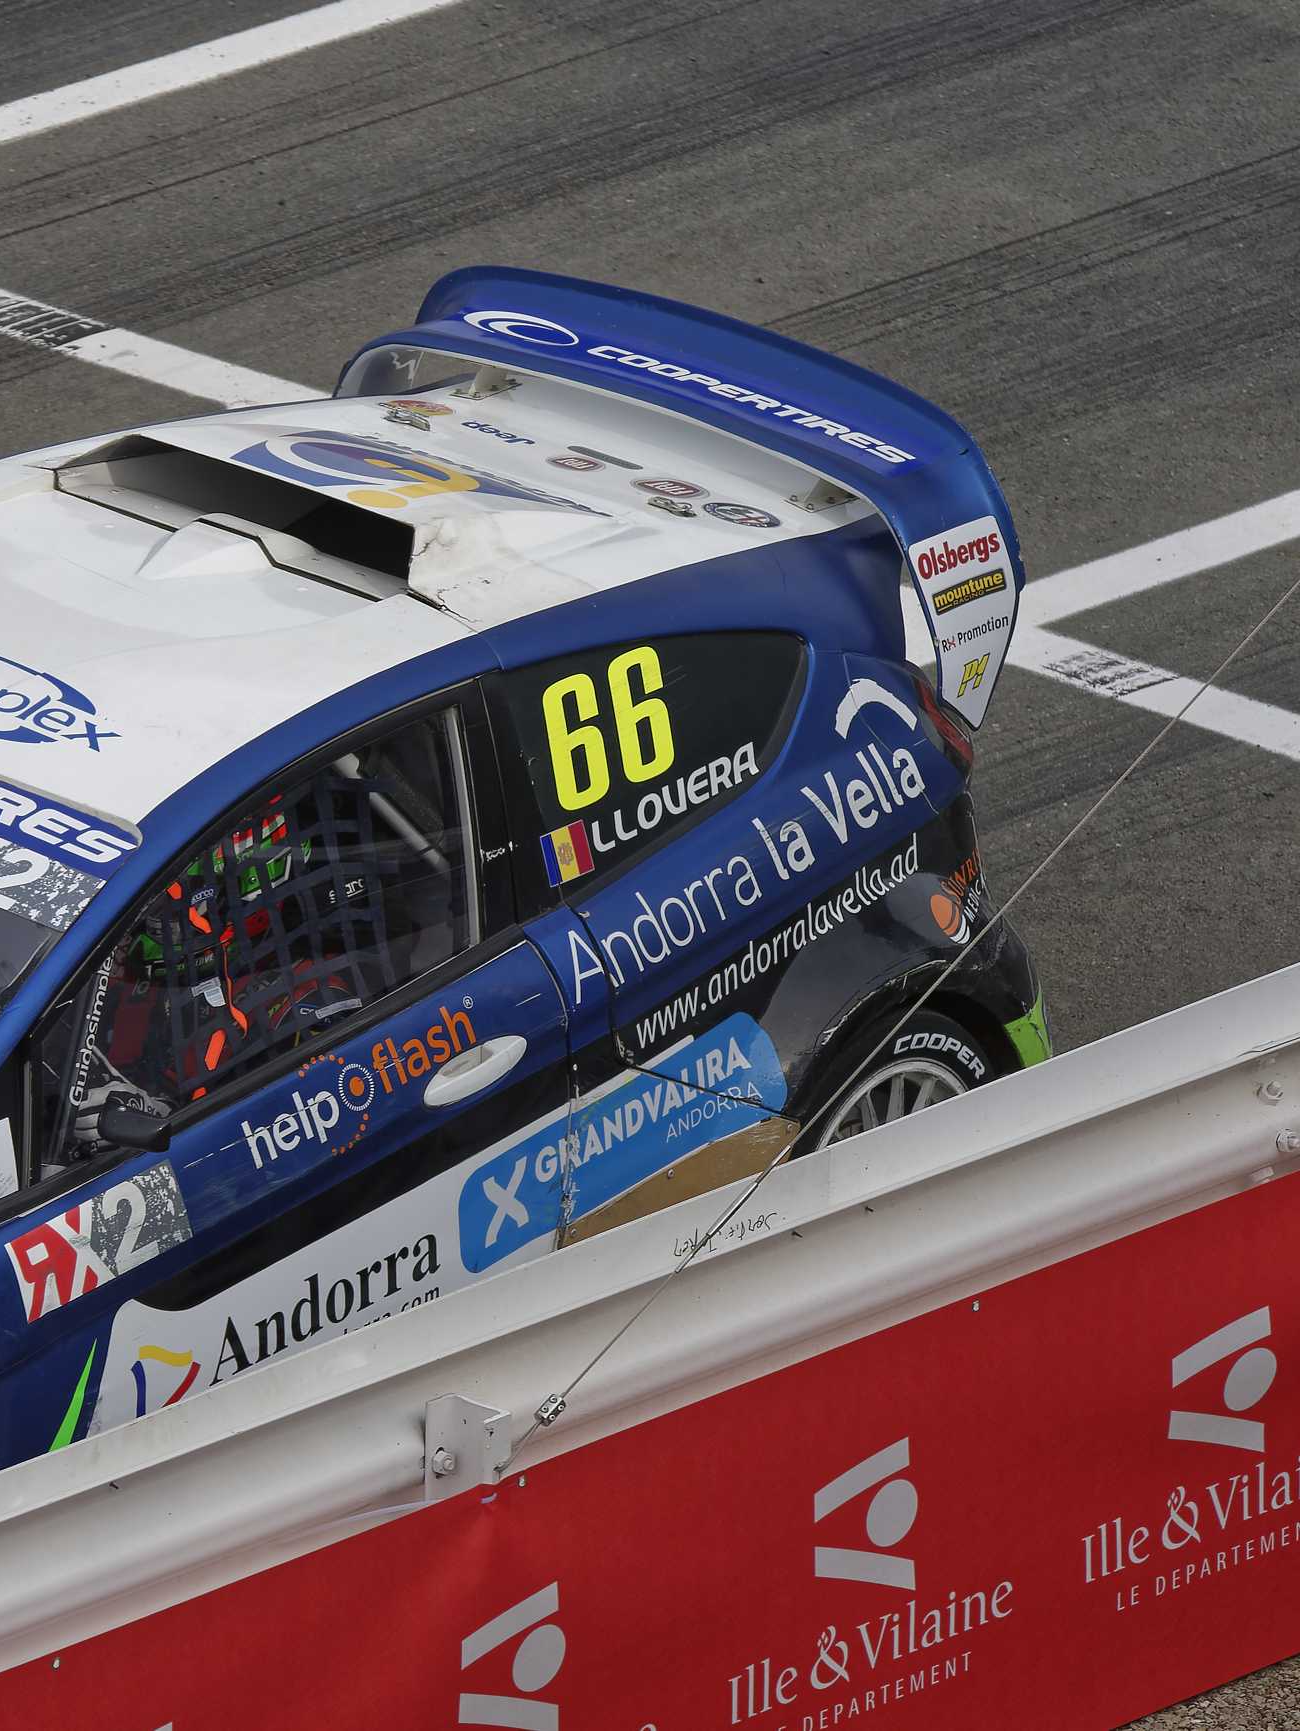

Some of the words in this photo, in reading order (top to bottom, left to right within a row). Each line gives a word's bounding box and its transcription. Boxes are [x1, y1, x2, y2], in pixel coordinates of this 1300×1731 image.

[460, 418, 537, 447] Jeep
[587, 343, 917, 466] COOPERTIRES
[917, 531, 1001, 580] Olsbergs
[933, 571, 1005, 609] mountune
[952, 588, 986, 608] RACING
[957, 614, 1010, 646] Promotion
[542, 646, 676, 812] 66
[568, 855, 763, 1005] Andorra
[751, 817, 817, 881] la
[800, 743, 927, 845] Vella
[635, 832, 920, 1050] www.andorralavella.ad
[893, 1032, 985, 1080] COOPER
[241, 1090, 341, 1169] help
[534, 1036, 753, 1184] GRANDVALIRA
[665, 1081, 764, 1143] ANDORRA
[209, 1233, 441, 1387] Andorra
[1082, 1516, 1150, 1584] Ille
[1162, 1485, 1202, 1550] &
[1116, 1584, 1140, 1612] LE
[728, 1657, 799, 1725] Ille
[810, 1625, 850, 1690] &
[856, 1579, 1014, 1671] Vilaine
[802, 1651, 973, 1731] DEPARTEMENT
